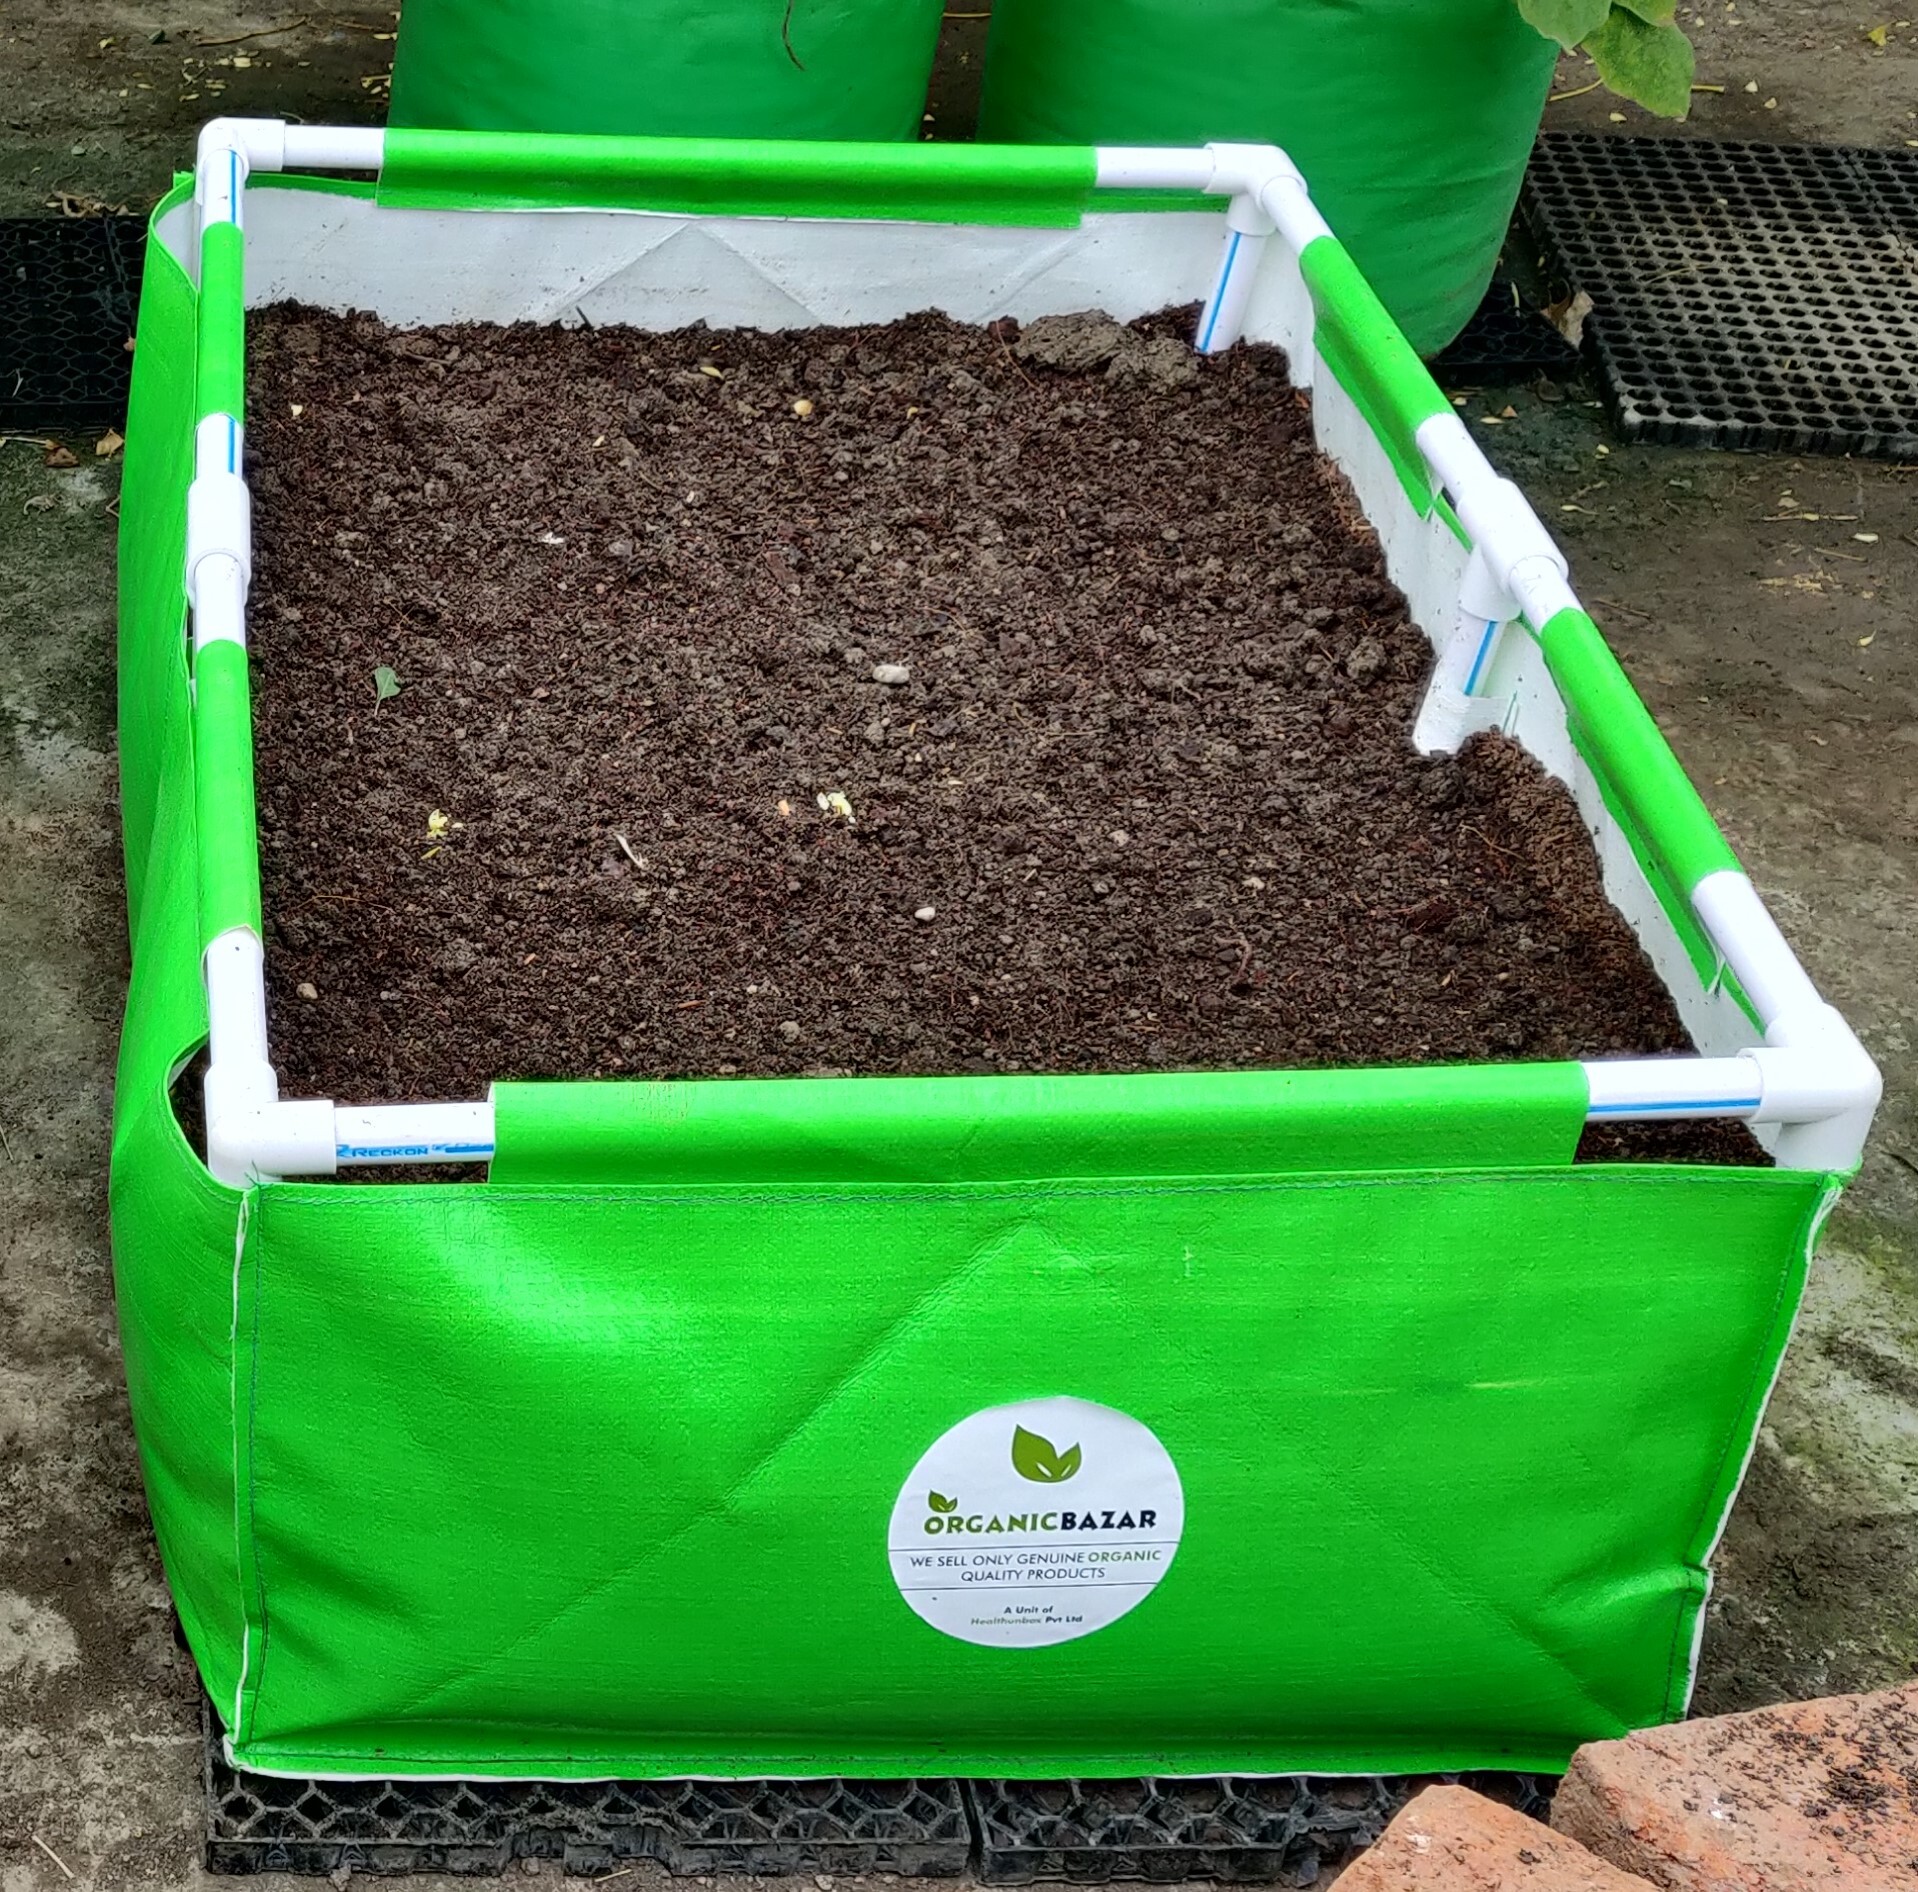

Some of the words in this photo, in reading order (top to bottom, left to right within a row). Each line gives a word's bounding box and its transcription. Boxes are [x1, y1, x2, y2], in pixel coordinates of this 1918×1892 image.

[352, 1146, 429, 1157] RECKON
[924, 1510, 1157, 1535] ORGANICBAZAR
[910, 1556, 933, 1568] WE
[937, 1555, 968, 1567] SELL
[972, 1554, 1013, 1567] ONLY
[1016, 1552, 1085, 1565] GENUINE
[1088, 1550, 1162, 1562] ORGANIC
[961, 1568, 1023, 1582] QUALITY
[1027, 1567, 1106, 1581] PRODUCTS
[1003, 1606, 1012, 1614] A
[1015, 1606, 1039, 1614] Unit
[1042, 1605, 1054, 1614] of
[1045, 1616, 1062, 1624] Pvt
[1066, 1615, 1083, 1623] Ltd
